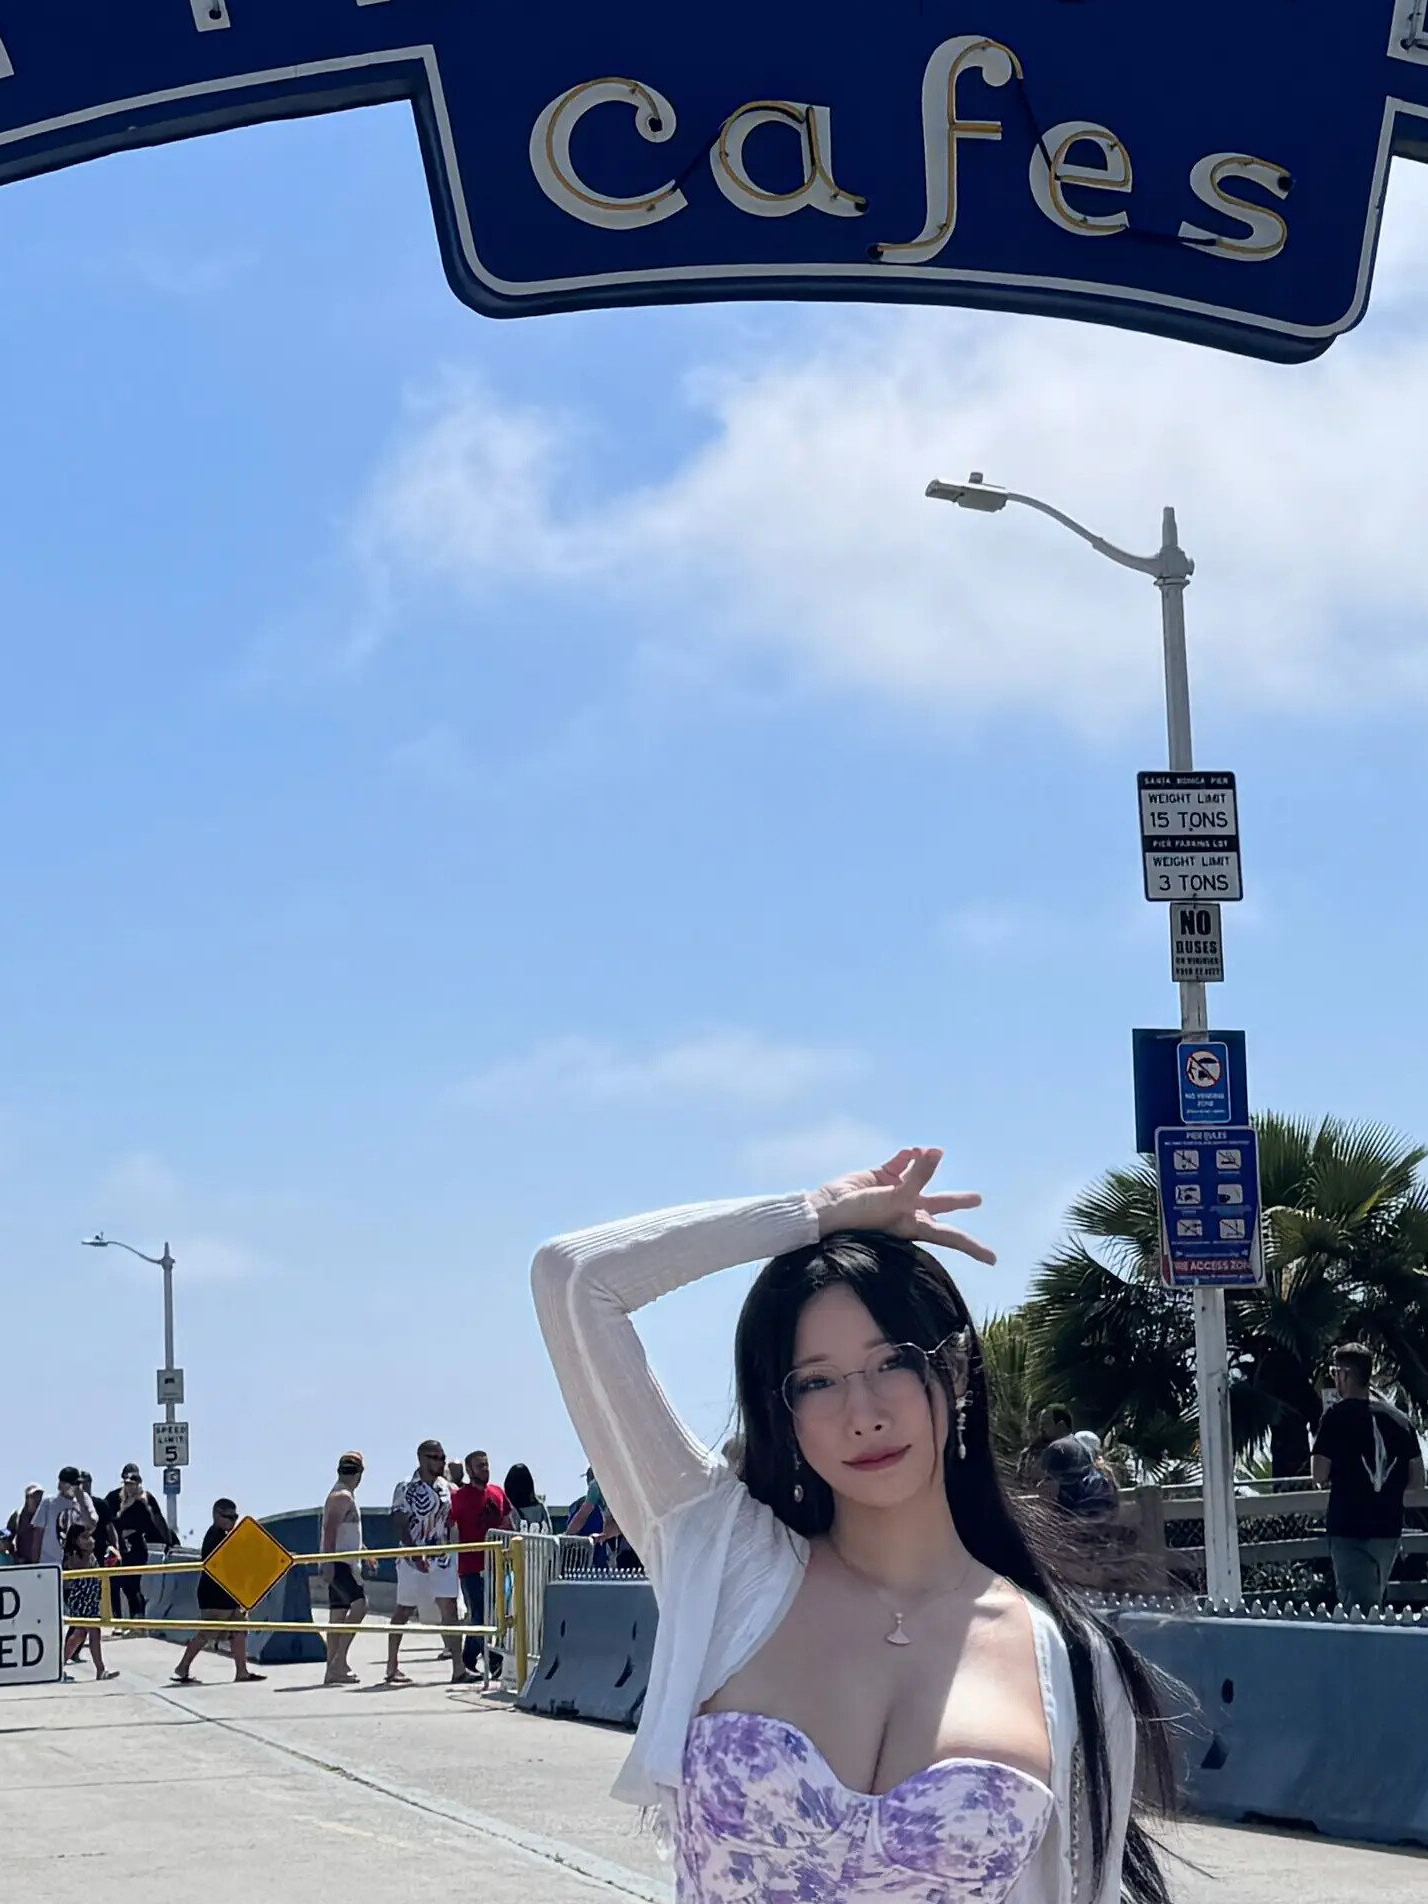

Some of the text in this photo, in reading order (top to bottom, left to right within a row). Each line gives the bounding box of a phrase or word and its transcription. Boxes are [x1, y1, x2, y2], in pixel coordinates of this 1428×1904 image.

[1148, 793, 1227, 804] WEIGHT LIMIT
[1150, 811, 1228, 828] 15 TONS
[1153, 856, 1230, 867] WEIGHT LIMIT
[1159, 874, 1229, 891] 3 TONS
[1180, 910, 1211, 935] NO
[1190, 1260, 1228, 1270] ACCESS
[165, 1445, 177, 1462] 5
